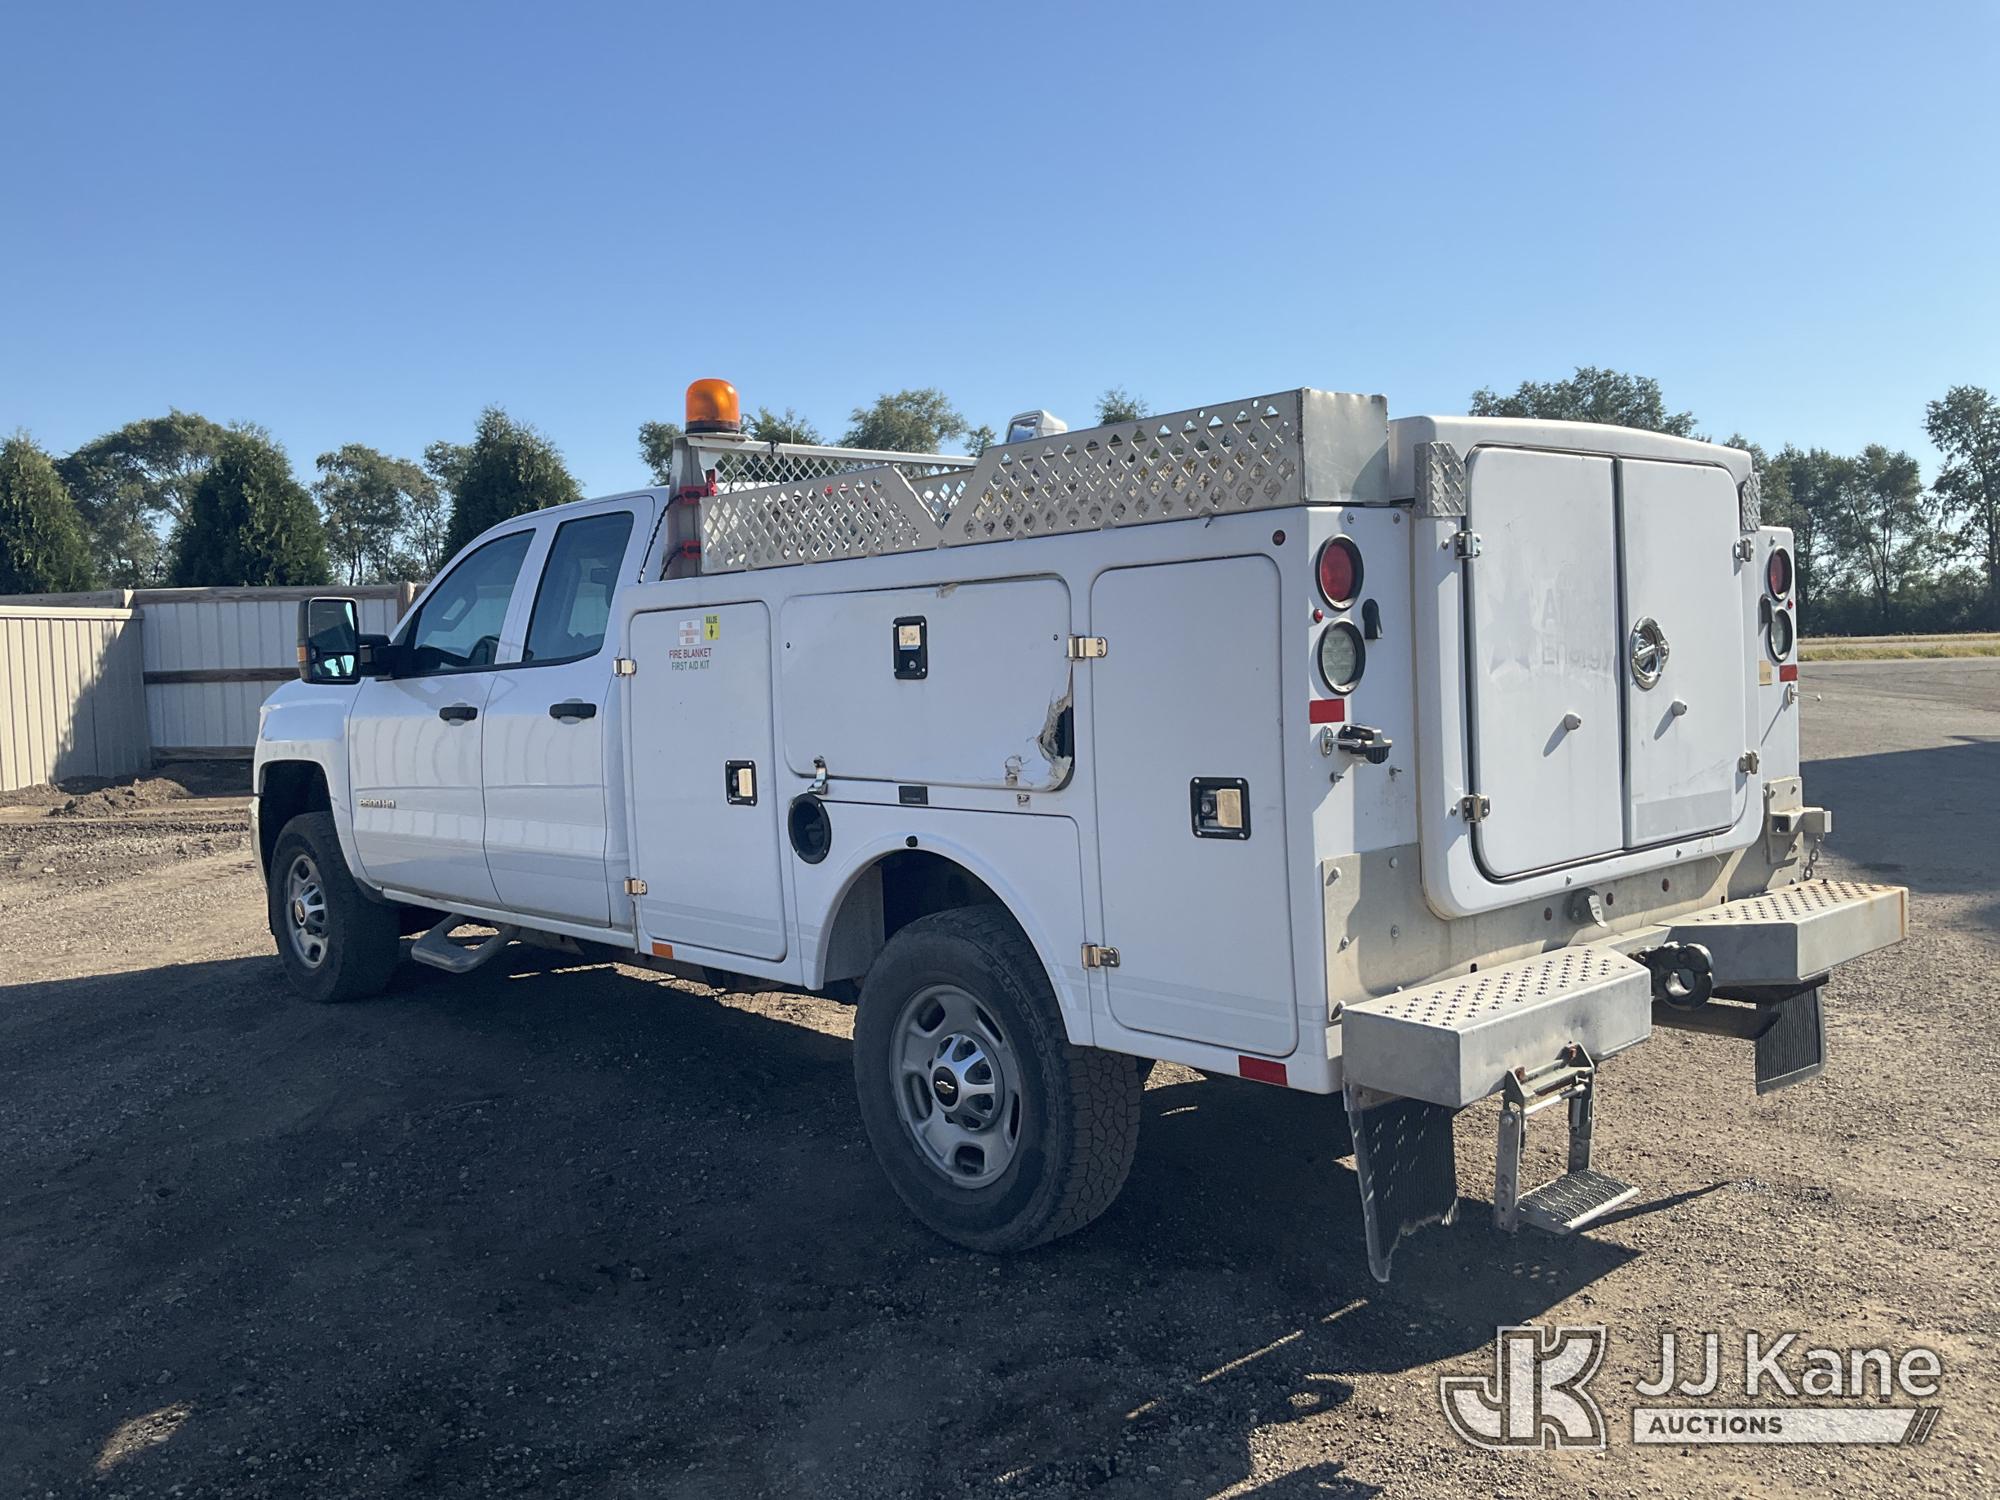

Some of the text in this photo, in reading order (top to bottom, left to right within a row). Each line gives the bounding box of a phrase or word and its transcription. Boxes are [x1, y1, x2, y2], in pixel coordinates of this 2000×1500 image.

[669, 648, 712, 659] FIRE BLANKET
[671, 659, 710, 671] FIRST AID KIT
